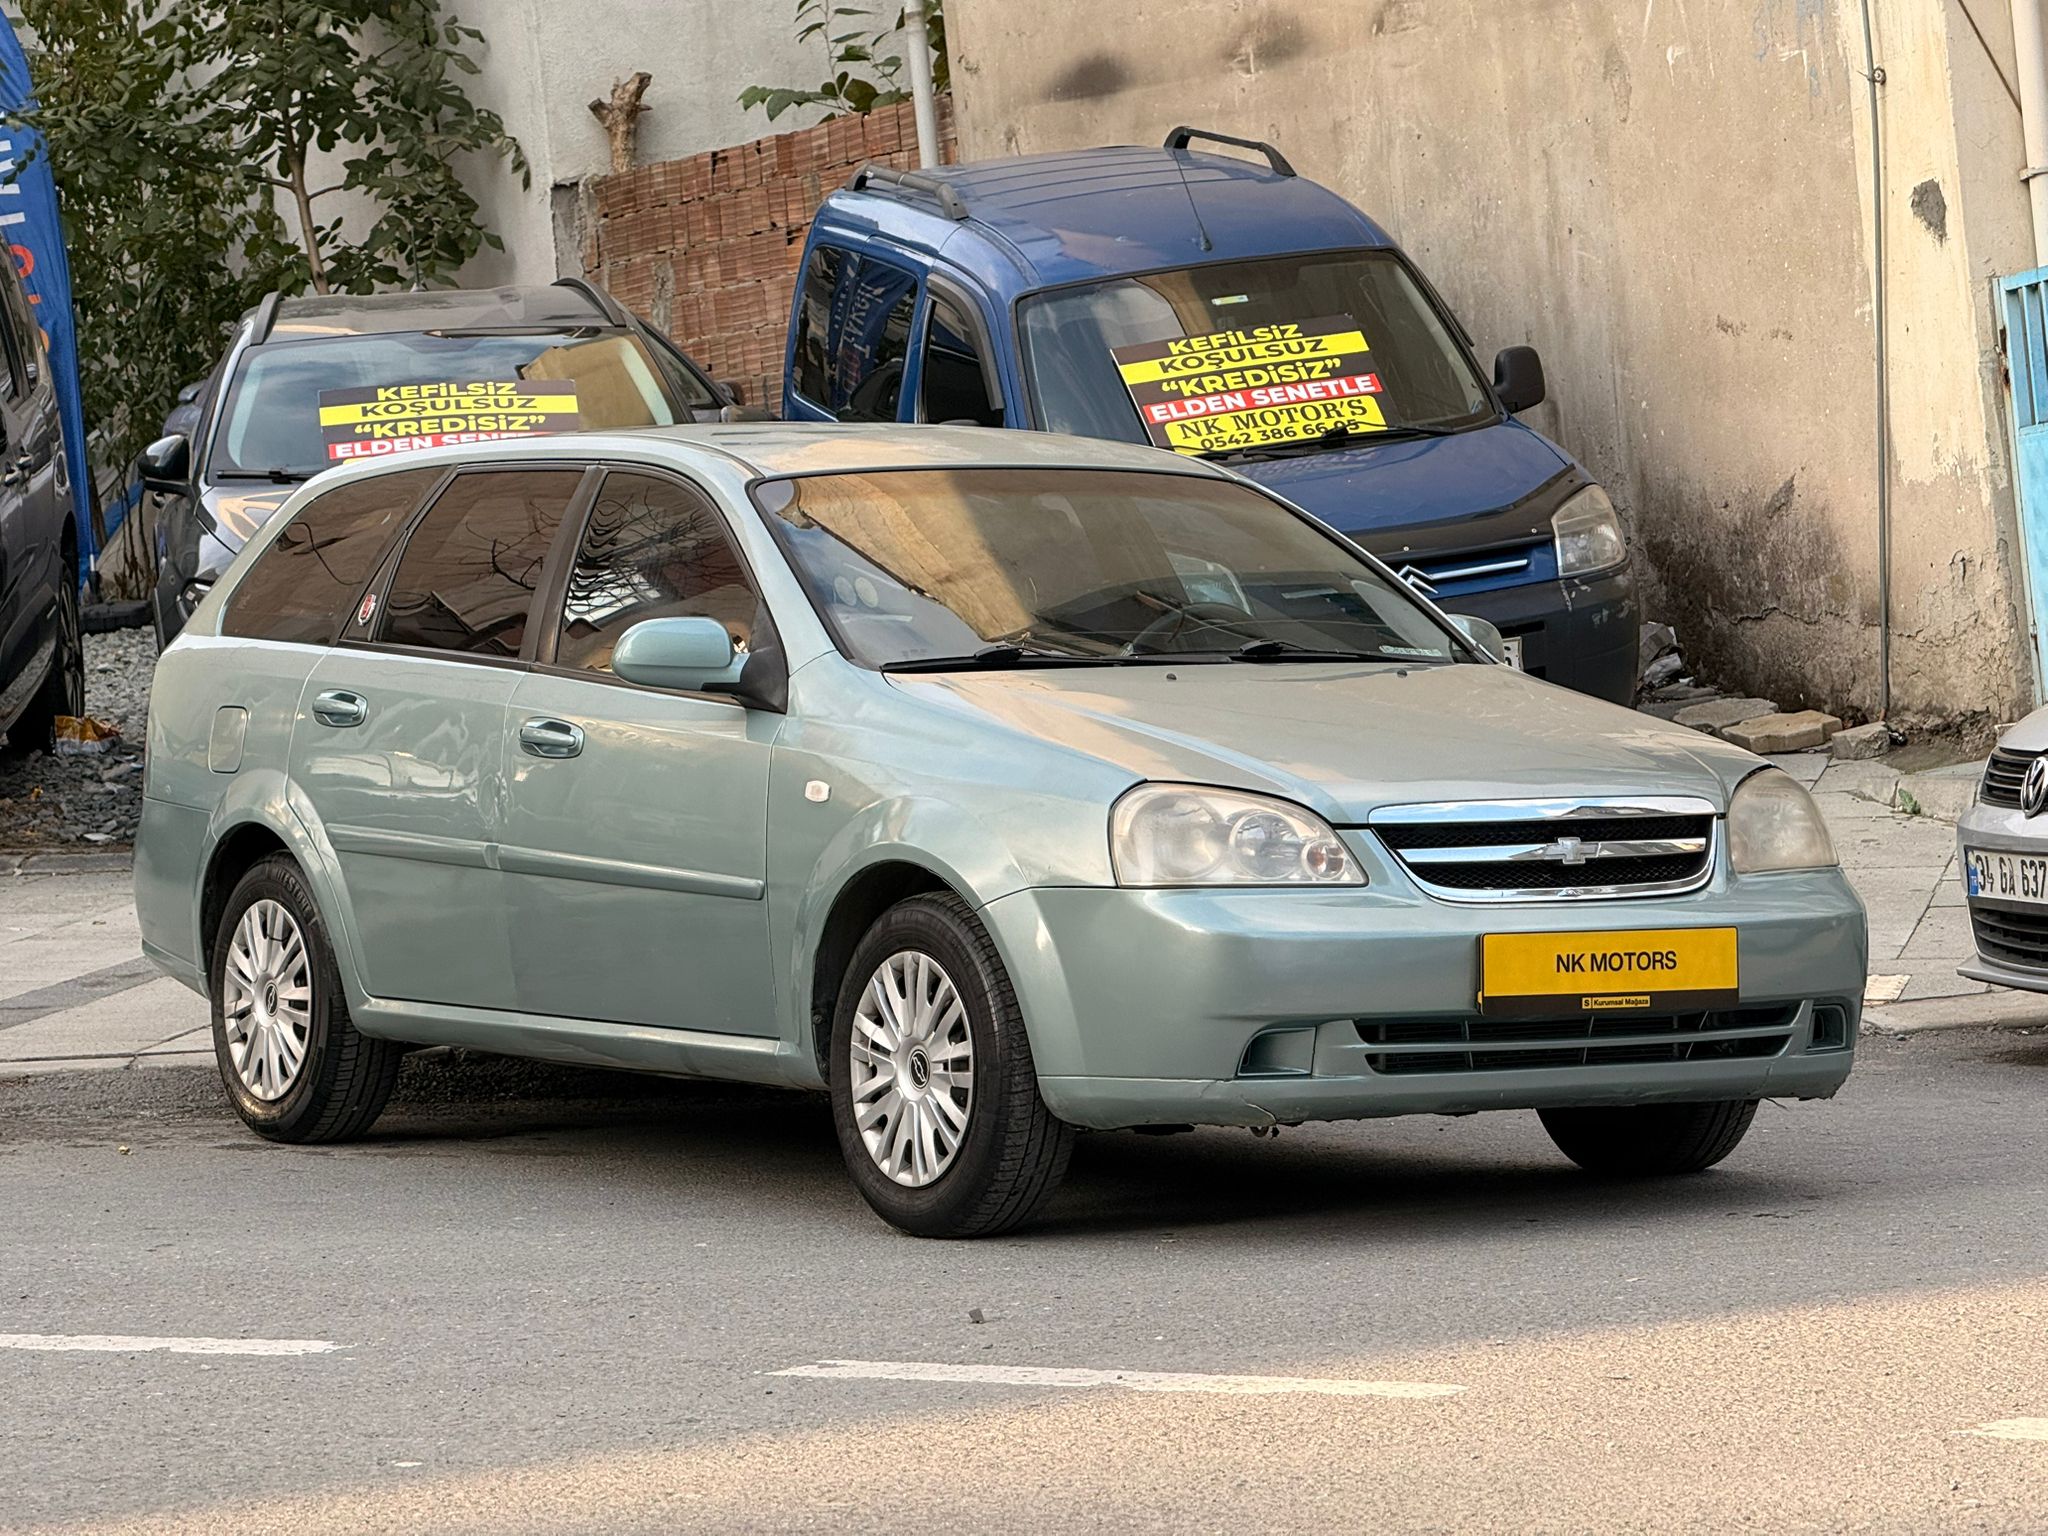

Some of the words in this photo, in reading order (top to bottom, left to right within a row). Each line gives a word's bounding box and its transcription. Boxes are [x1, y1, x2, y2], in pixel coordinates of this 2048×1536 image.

[1159, 338, 1328, 373] KOŞULSUZ
[361, 397, 538, 417] KOŞULSUZ
[1150, 393, 1246, 421] ELDEN
[1251, 376, 1376, 405] SENETLE
[1177, 418, 1227, 440] NK
[1200, 432, 1254, 450] 0542
[1257, 426, 1298, 441] 386
[1302, 422, 1328, 436] 66
[335, 436, 433, 458] ELDEN
[1975, 855, 1995, 892] 34
[1999, 856, 2016, 895] GA
[2020, 859, 2047, 899] 637
[1556, 953, 1586, 973] NK
[1590, 951, 1677, 972] MOTORS
[1593, 997, 1624, 1006] Kurumsal
